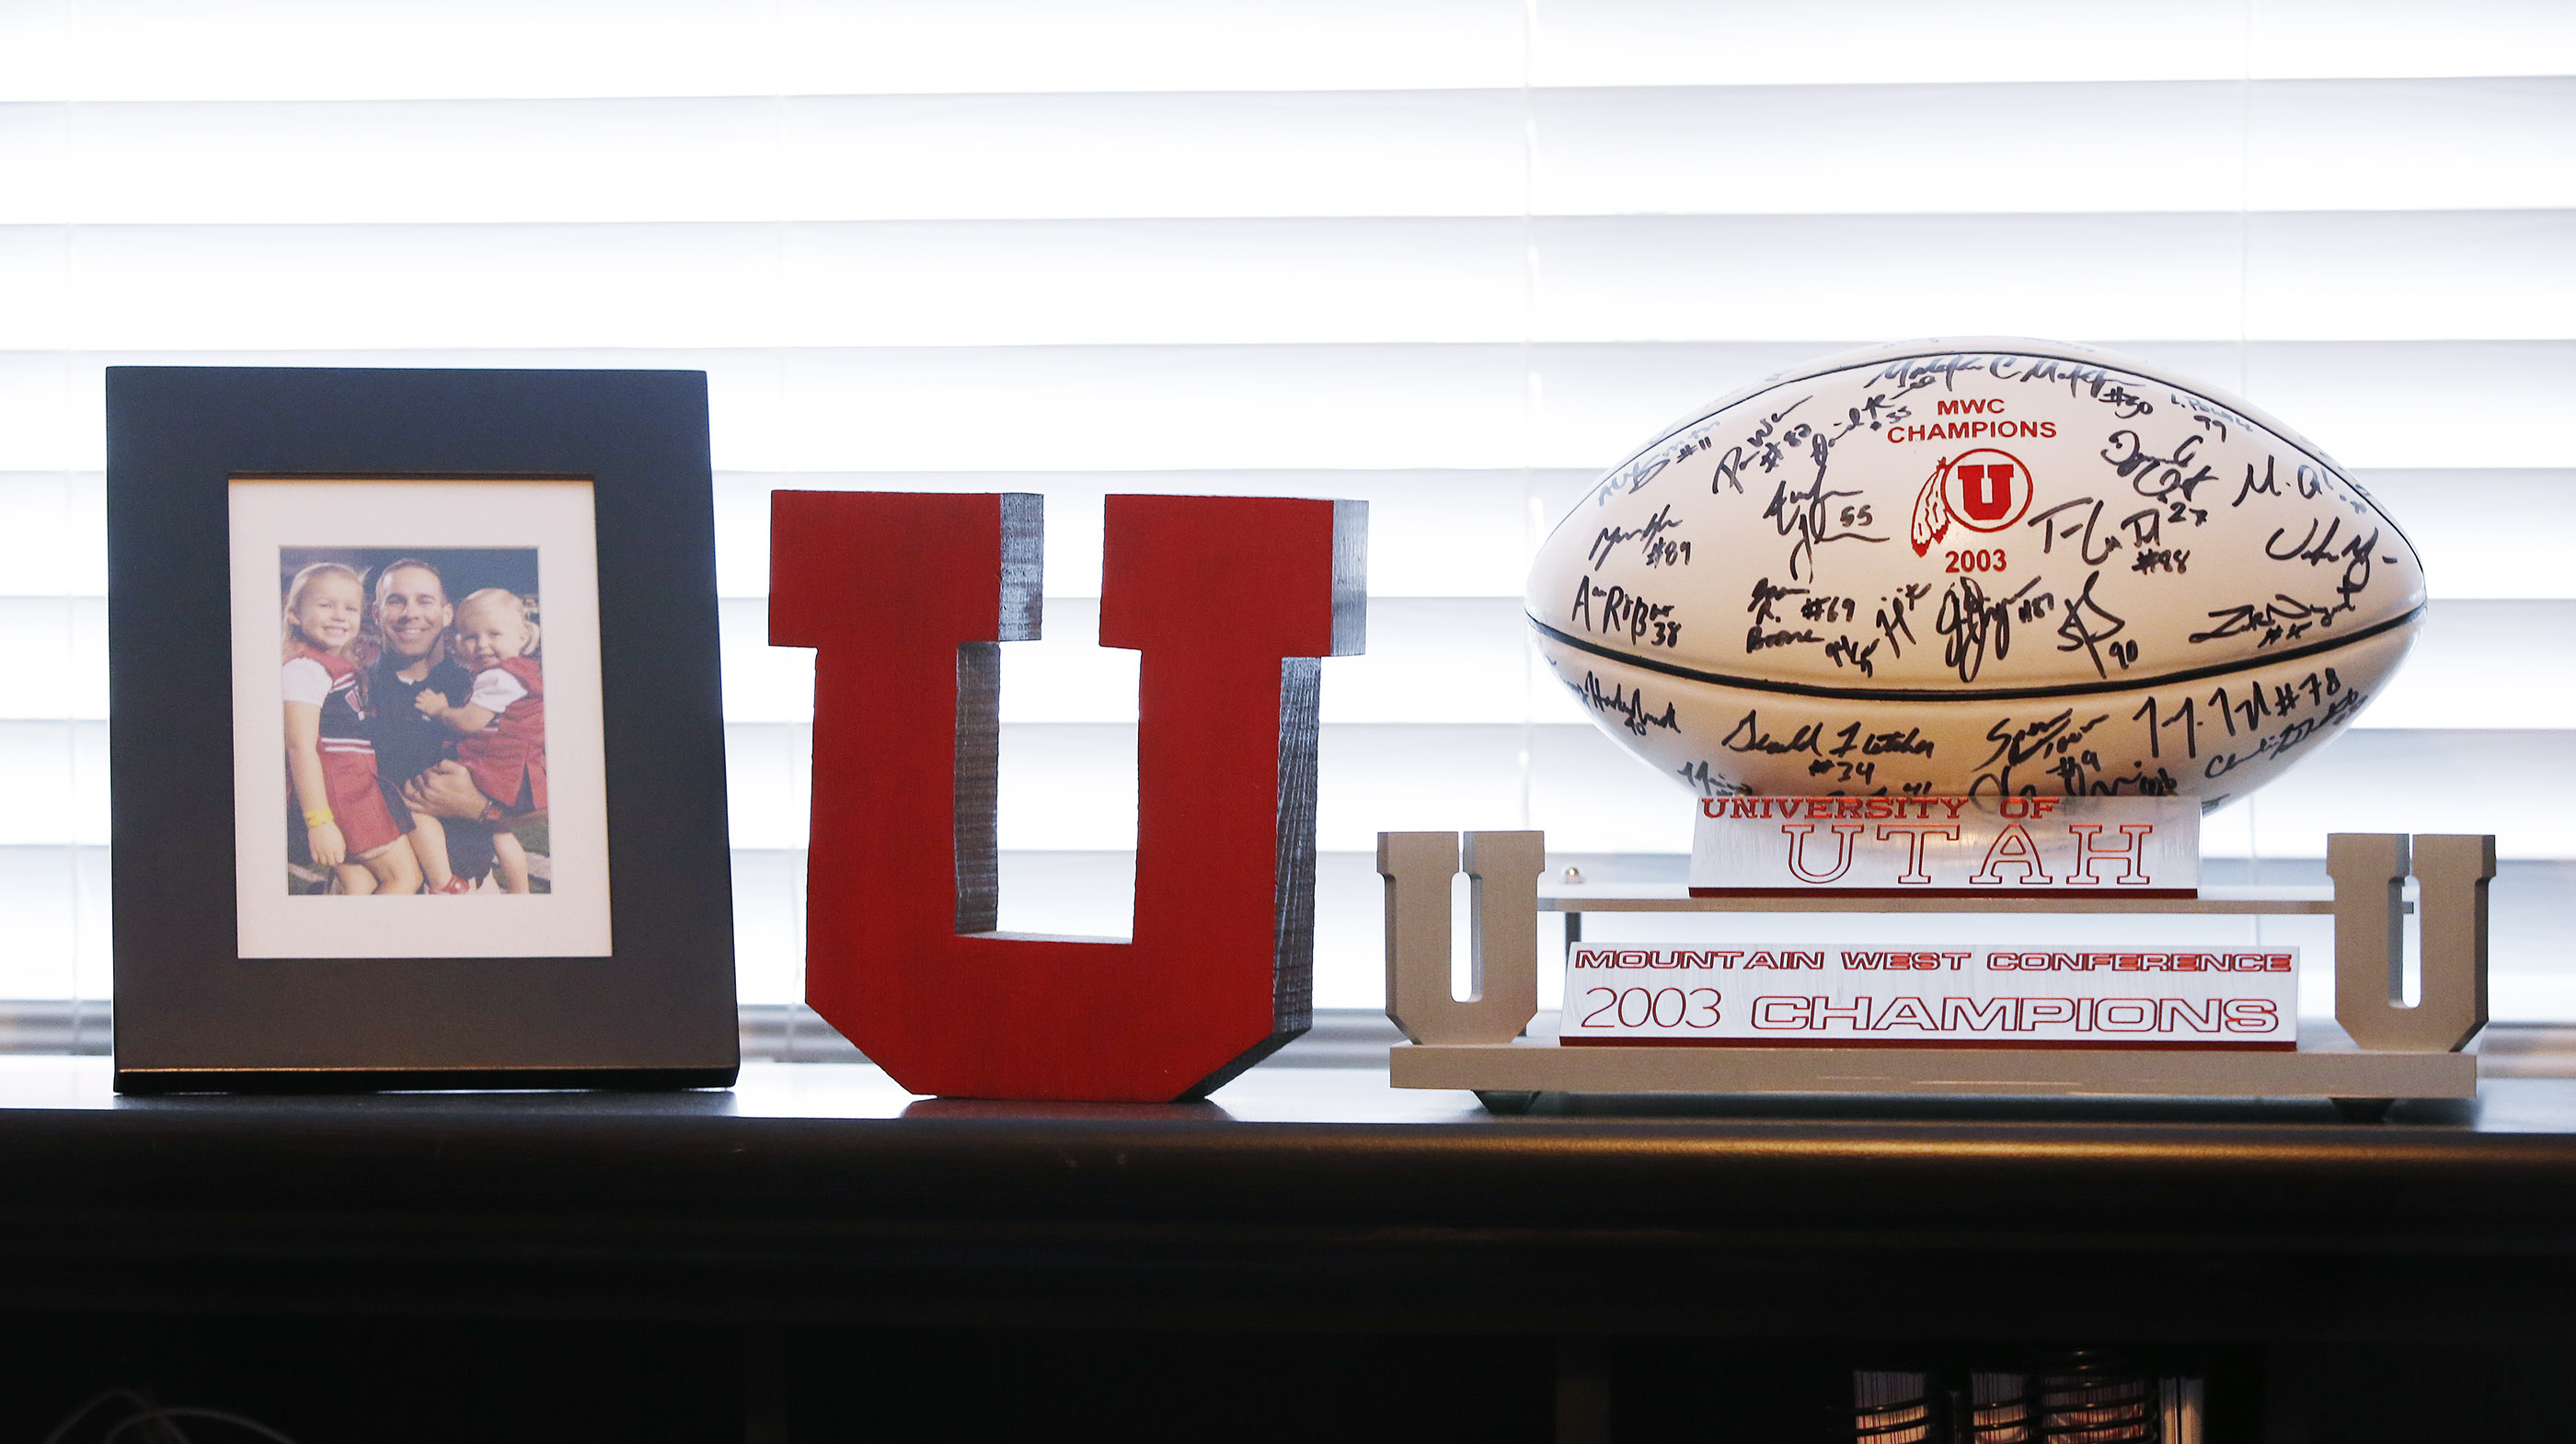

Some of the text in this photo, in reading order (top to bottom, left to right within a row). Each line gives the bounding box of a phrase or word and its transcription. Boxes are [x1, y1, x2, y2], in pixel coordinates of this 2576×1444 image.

[1938, 398, 2005, 416] MWC
[1887, 420, 2057, 443] CHAMPIONS
[1945, 548, 2007, 573] 2003
[1650, 621, 1682, 648] 38
[2274, 668, 2341, 716] #78
[1809, 759, 1876, 785] #34
[1702, 796, 2061, 819] UNIVERSITY OF
[1782, 823, 2153, 885] UTAH
[1575, 950, 2293, 973] MOUNTAIN WEST CONFERENCE
[1581, 987, 2279, 1034] 2003 CHAMPIONS
